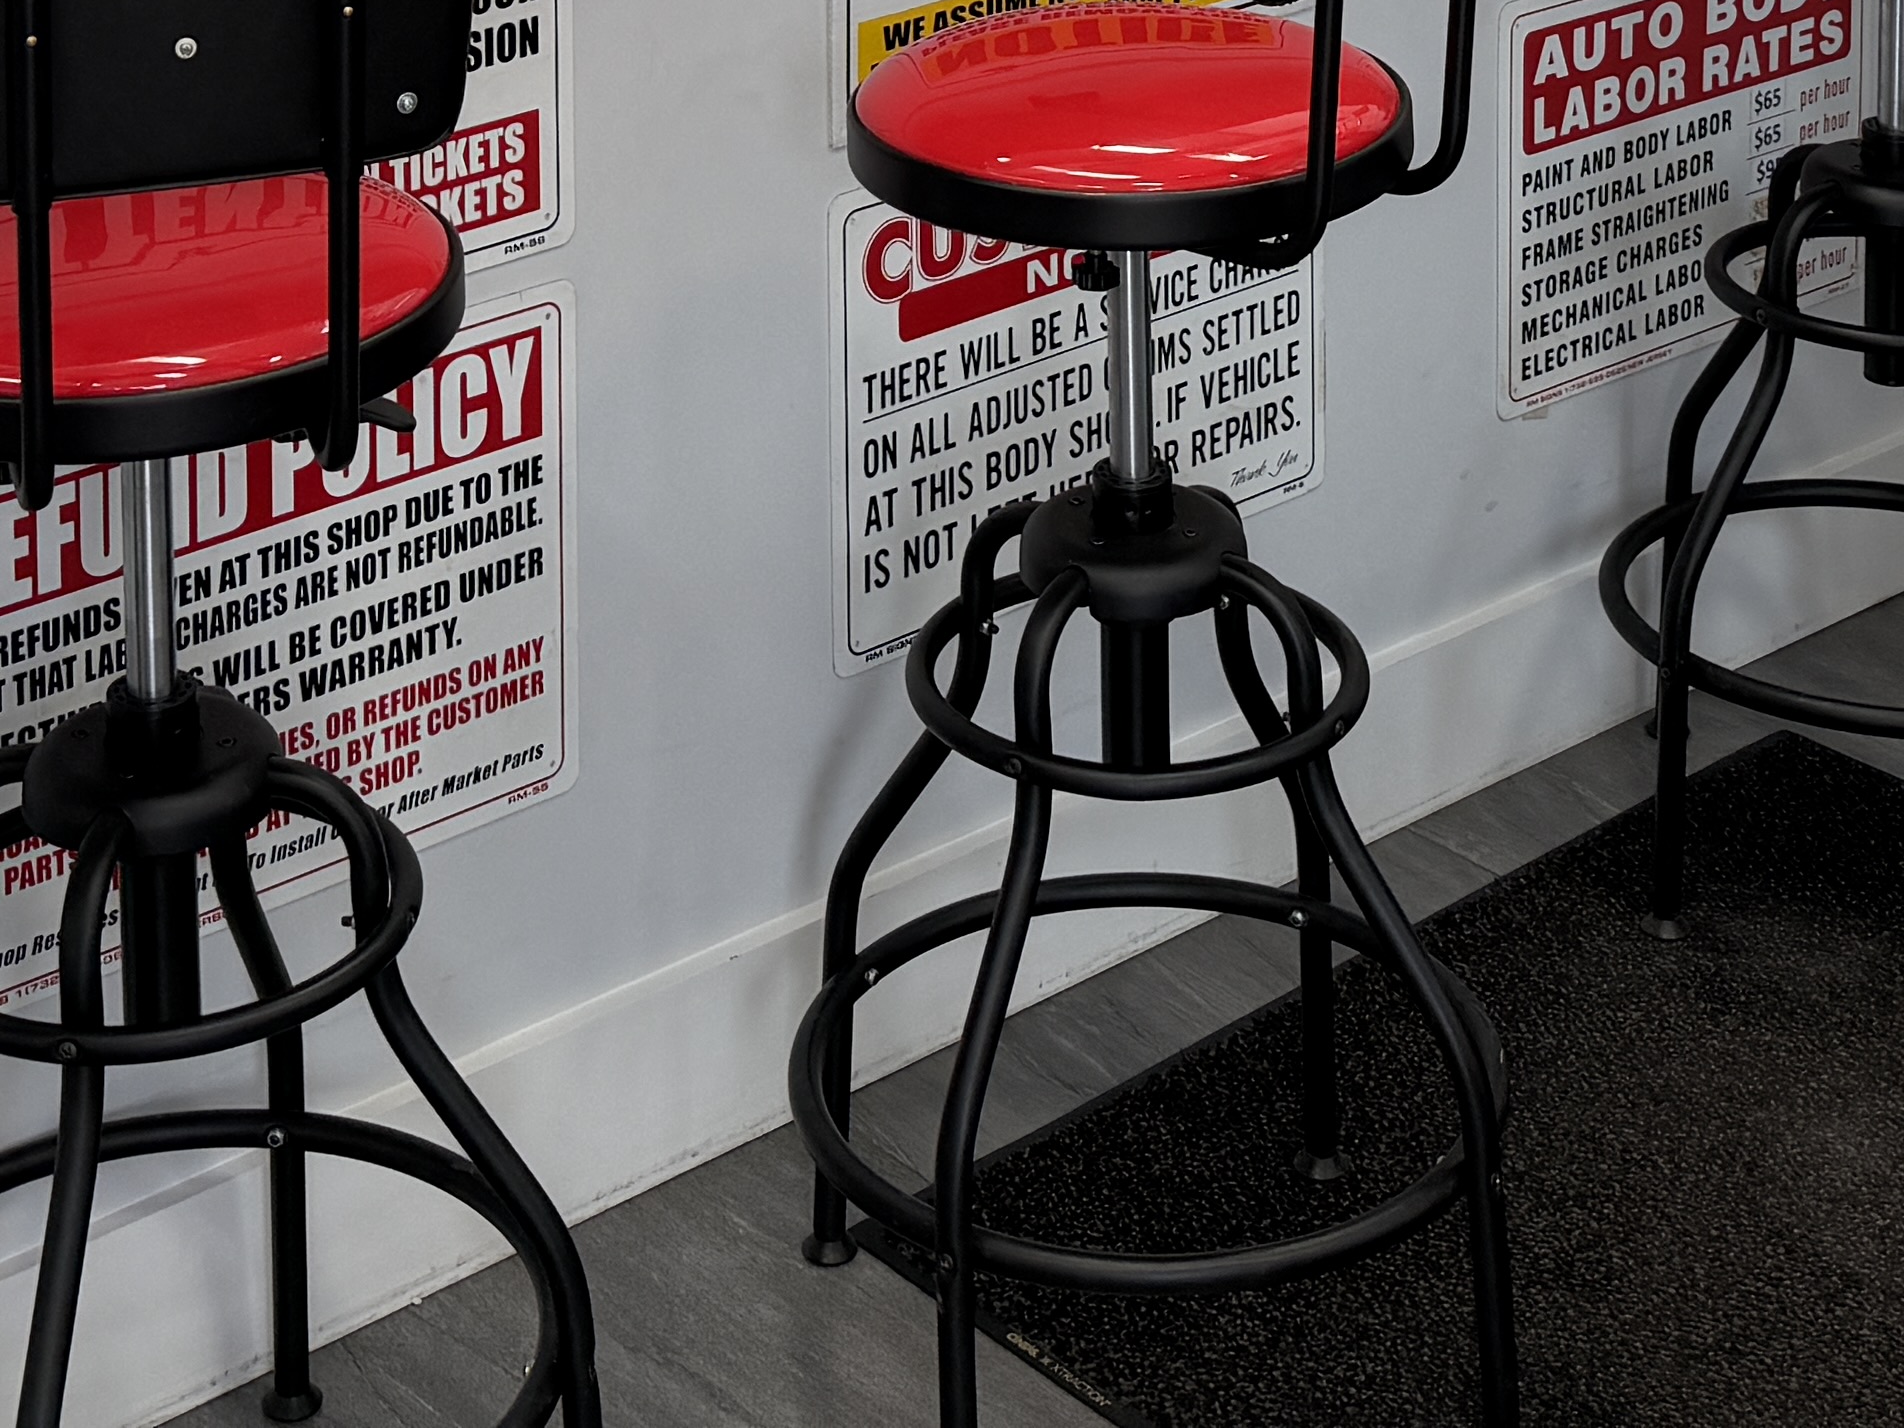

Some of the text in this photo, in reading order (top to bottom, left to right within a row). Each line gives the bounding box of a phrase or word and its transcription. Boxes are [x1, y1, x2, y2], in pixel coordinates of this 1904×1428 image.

[1533, 0, 1684, 86] AUTO
[1533, 9, 1844, 144] LABOR RATES
[390, 121, 526, 187] TICKETS
[1522, 77, 1851, 197] PAINT AND BODY LABOR $65 per hour
[1200, 340, 1301, 410] VEHICLE
[1521, 294, 1705, 381] ELECTRICAL LABOR
[863, 363, 1093, 479] ON ALL ADJUSTED
[1191, 395, 1301, 468] REPAIRS.
[295, 498, 543, 611] ARE NOT REFUNDABLE.
[299, 617, 462, 700] WARRANTY.
